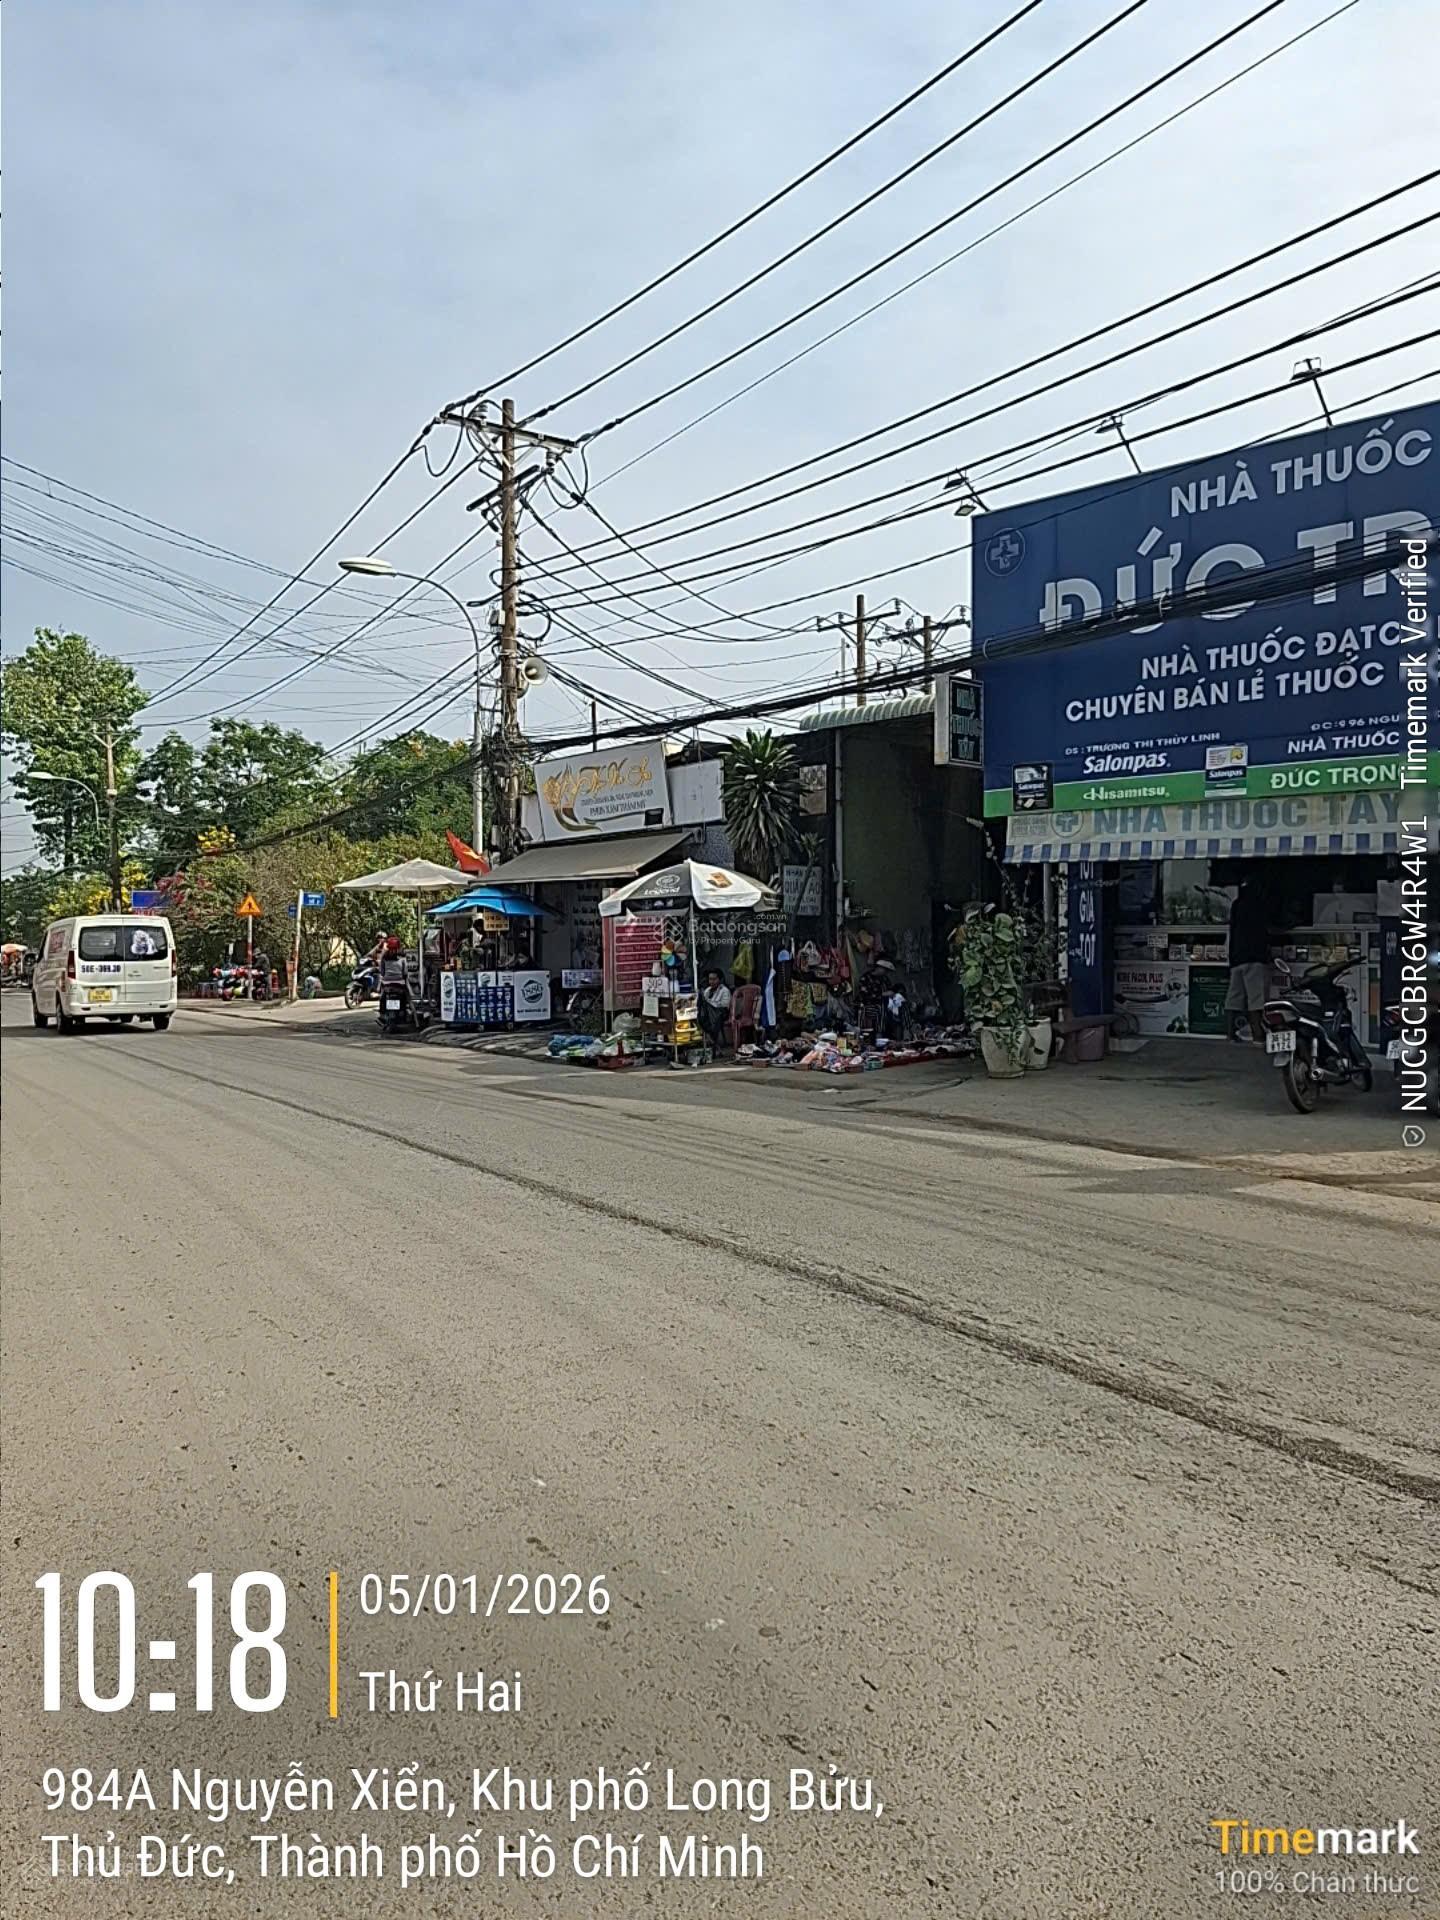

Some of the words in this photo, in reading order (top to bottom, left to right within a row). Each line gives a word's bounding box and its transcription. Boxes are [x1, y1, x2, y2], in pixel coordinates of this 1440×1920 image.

[1170, 460, 1258, 518] NHÀ
[1271, 418, 1432, 495] THUỐC
[1141, 644, 1199, 680] NHÀ
[1206, 626, 1305, 671] THUỐC
[1066, 684, 1165, 722] CHUYÊN
[1174, 677, 1229, 710] BÁN
[1238, 668, 1265, 703] LẺ
[1275, 655, 1385, 697] THUỐC
[1368, 714, 1400, 726] NGU
[1191, 732, 1221, 743] LINH
[1287, 736, 1327, 754] NHÀ
[1332, 729, 1400, 751] THUỐC
[1083, 752, 1169, 775] Salonpas
[1209, 768, 1243, 779] Salonpas
[1270, 768, 1321, 789] ĐỨC
[1327, 764, 1400, 785] TRỌN
[1083, 786, 1166, 801] Hisamitsu
